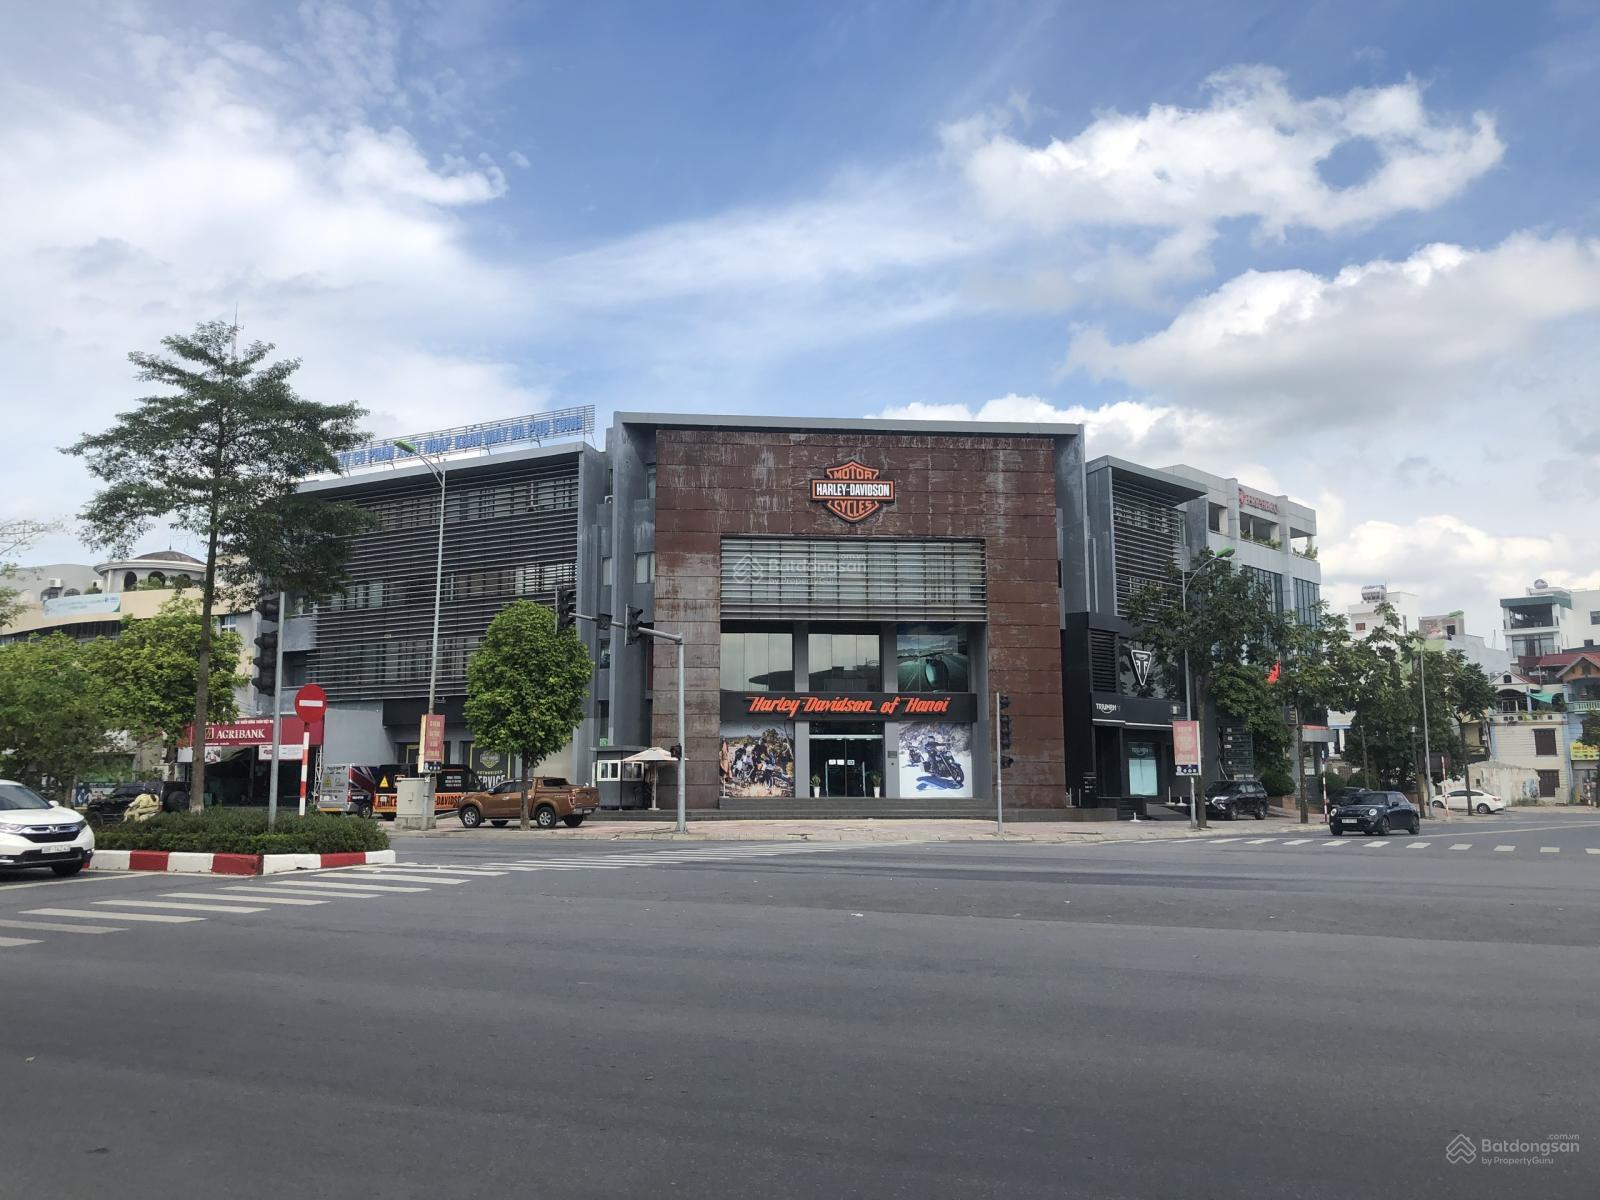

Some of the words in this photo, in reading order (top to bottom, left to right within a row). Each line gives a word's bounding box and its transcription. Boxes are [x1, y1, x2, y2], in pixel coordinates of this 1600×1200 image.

[834, 466, 873, 479] MOTOR
[816, 483, 890, 496] HARLEY-DAVIDSON
[834, 500, 873, 517] CYCLES
[880, 697, 900, 714] of
[902, 697, 951, 713] Hanoi
[1095, 703, 1117, 713] TRIUMPH
[216, 729, 265, 739] AGRIBANK
